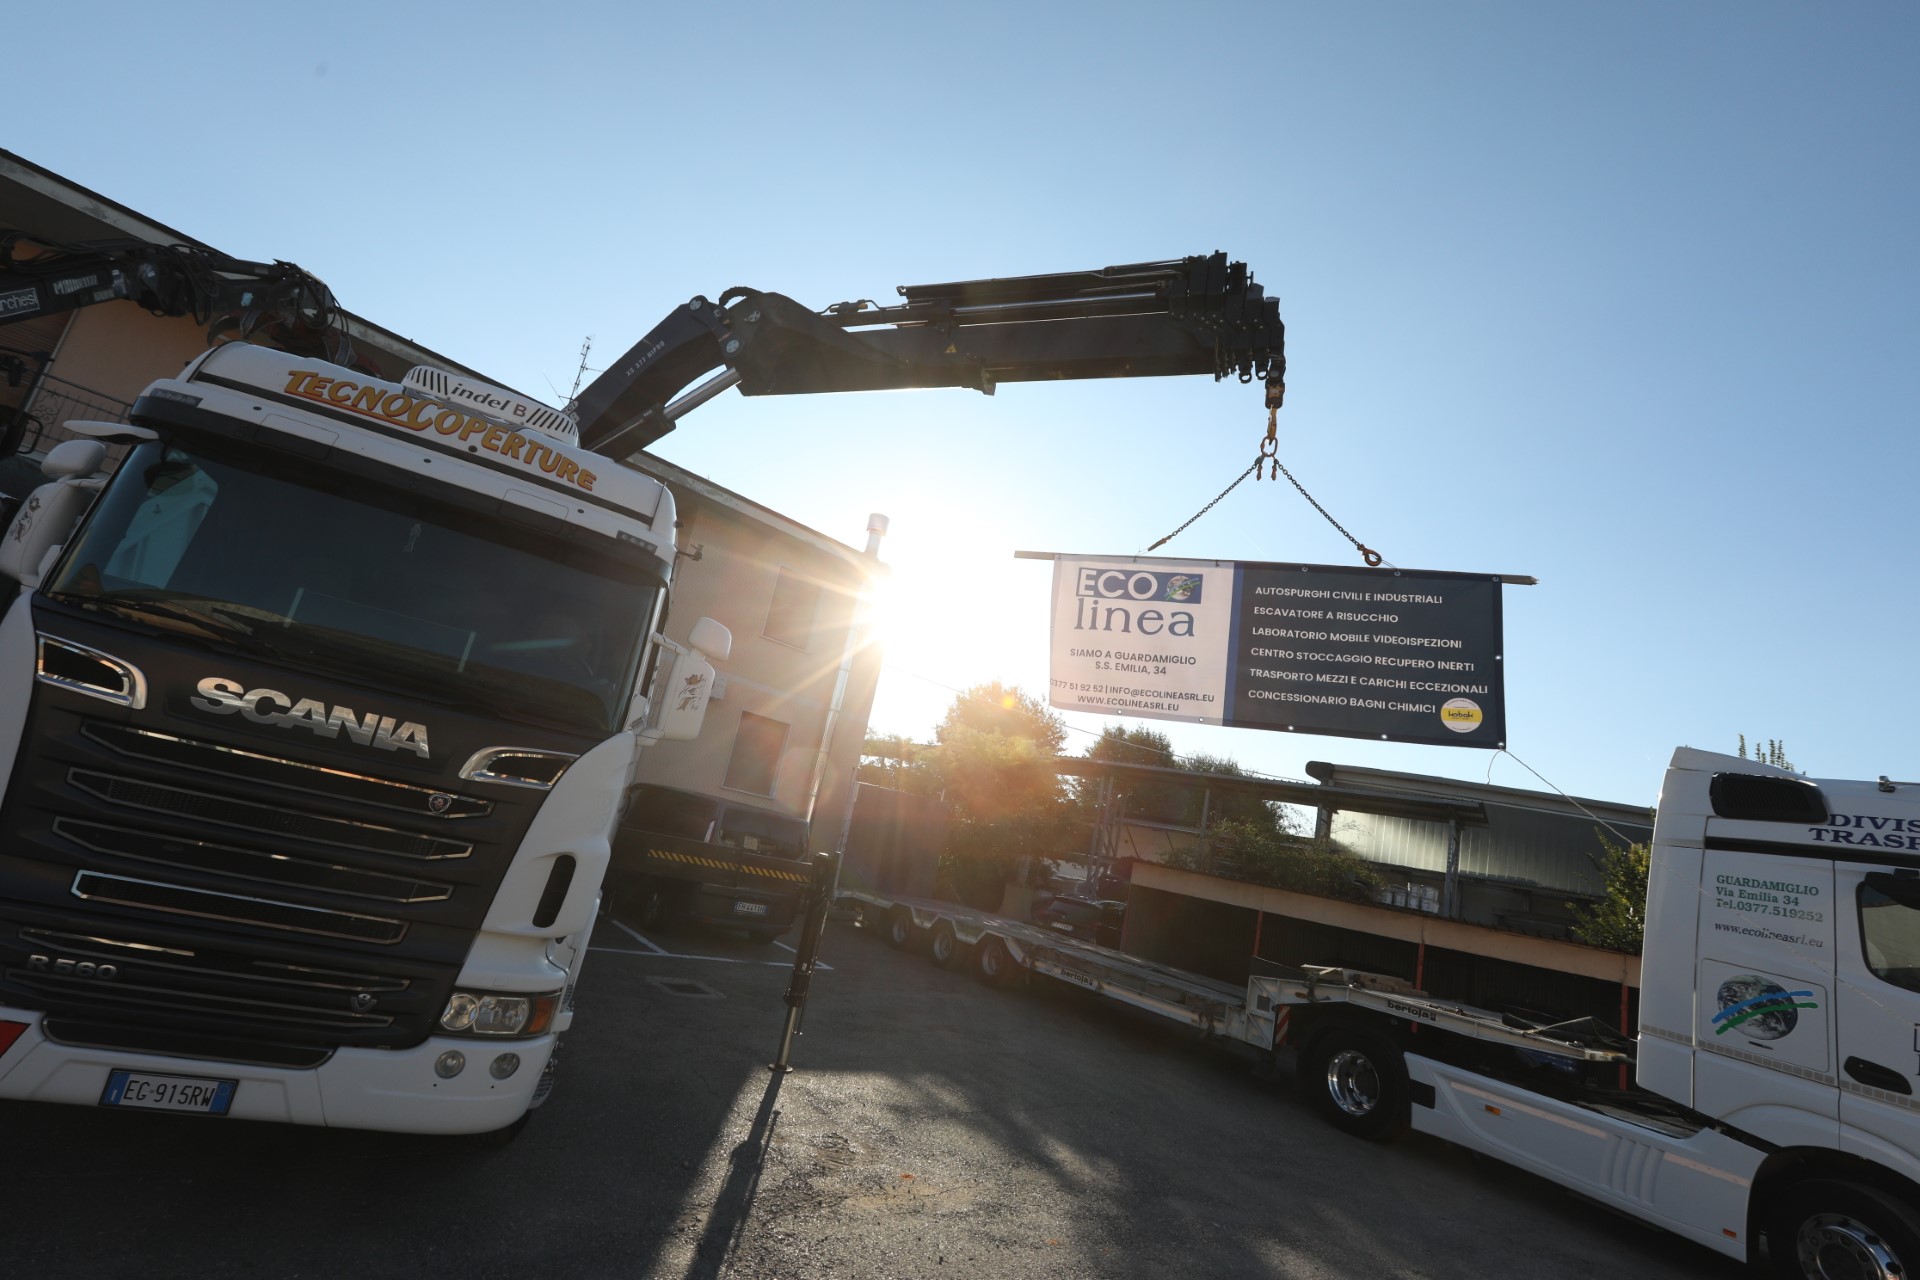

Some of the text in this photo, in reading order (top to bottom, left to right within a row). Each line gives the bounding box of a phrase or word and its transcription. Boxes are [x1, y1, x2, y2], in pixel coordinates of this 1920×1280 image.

[450, 382, 527, 417] indel B
[1078, 568, 1158, 600] ECO
[1255, 586, 1443, 604] AUTOSPURGHI CIVILI E INDUSTRIALI
[1074, 598, 1195, 637] linea
[1253, 606, 1399, 623] ESCAVATORE A RISUCCHIO
[1252, 626, 1462, 648] LABORATORIO MOBILE VIDEOISPEZIONI
[1070, 648, 1197, 666] SIAMO A GUARDAMIGLIO
[1095, 661, 1167, 675] S.S. EMILIA, 34
[1250, 647, 1475, 672] CENTRO STOCCAGGIO RECUPERO INERTI
[1250, 668, 1488, 694] TRASPORTO MEZZI E CARICHI ECCEZIONALI
[1069, 682, 1078, 690] 51
[1080, 683, 1091, 692] 92
[1092, 684, 1104, 693] 52
[1109, 686, 1215, 703] INFO@ECOLINEASRL.EU
[1077, 695, 1180, 712] WWW.ECOLINEASRL.EU
[1248, 689, 1348, 705] CONCESSIONARIO
[1349, 697, 1386, 709] BAGNI
[1388, 701, 1436, 713] CHIMICI
[189, 677, 430, 760] SCANIA
[1715, 886, 1800, 906] Via Emilia 34
[1716, 874, 1820, 896] GUARDAMIGLIO
[27, 954, 118, 980] R 560
